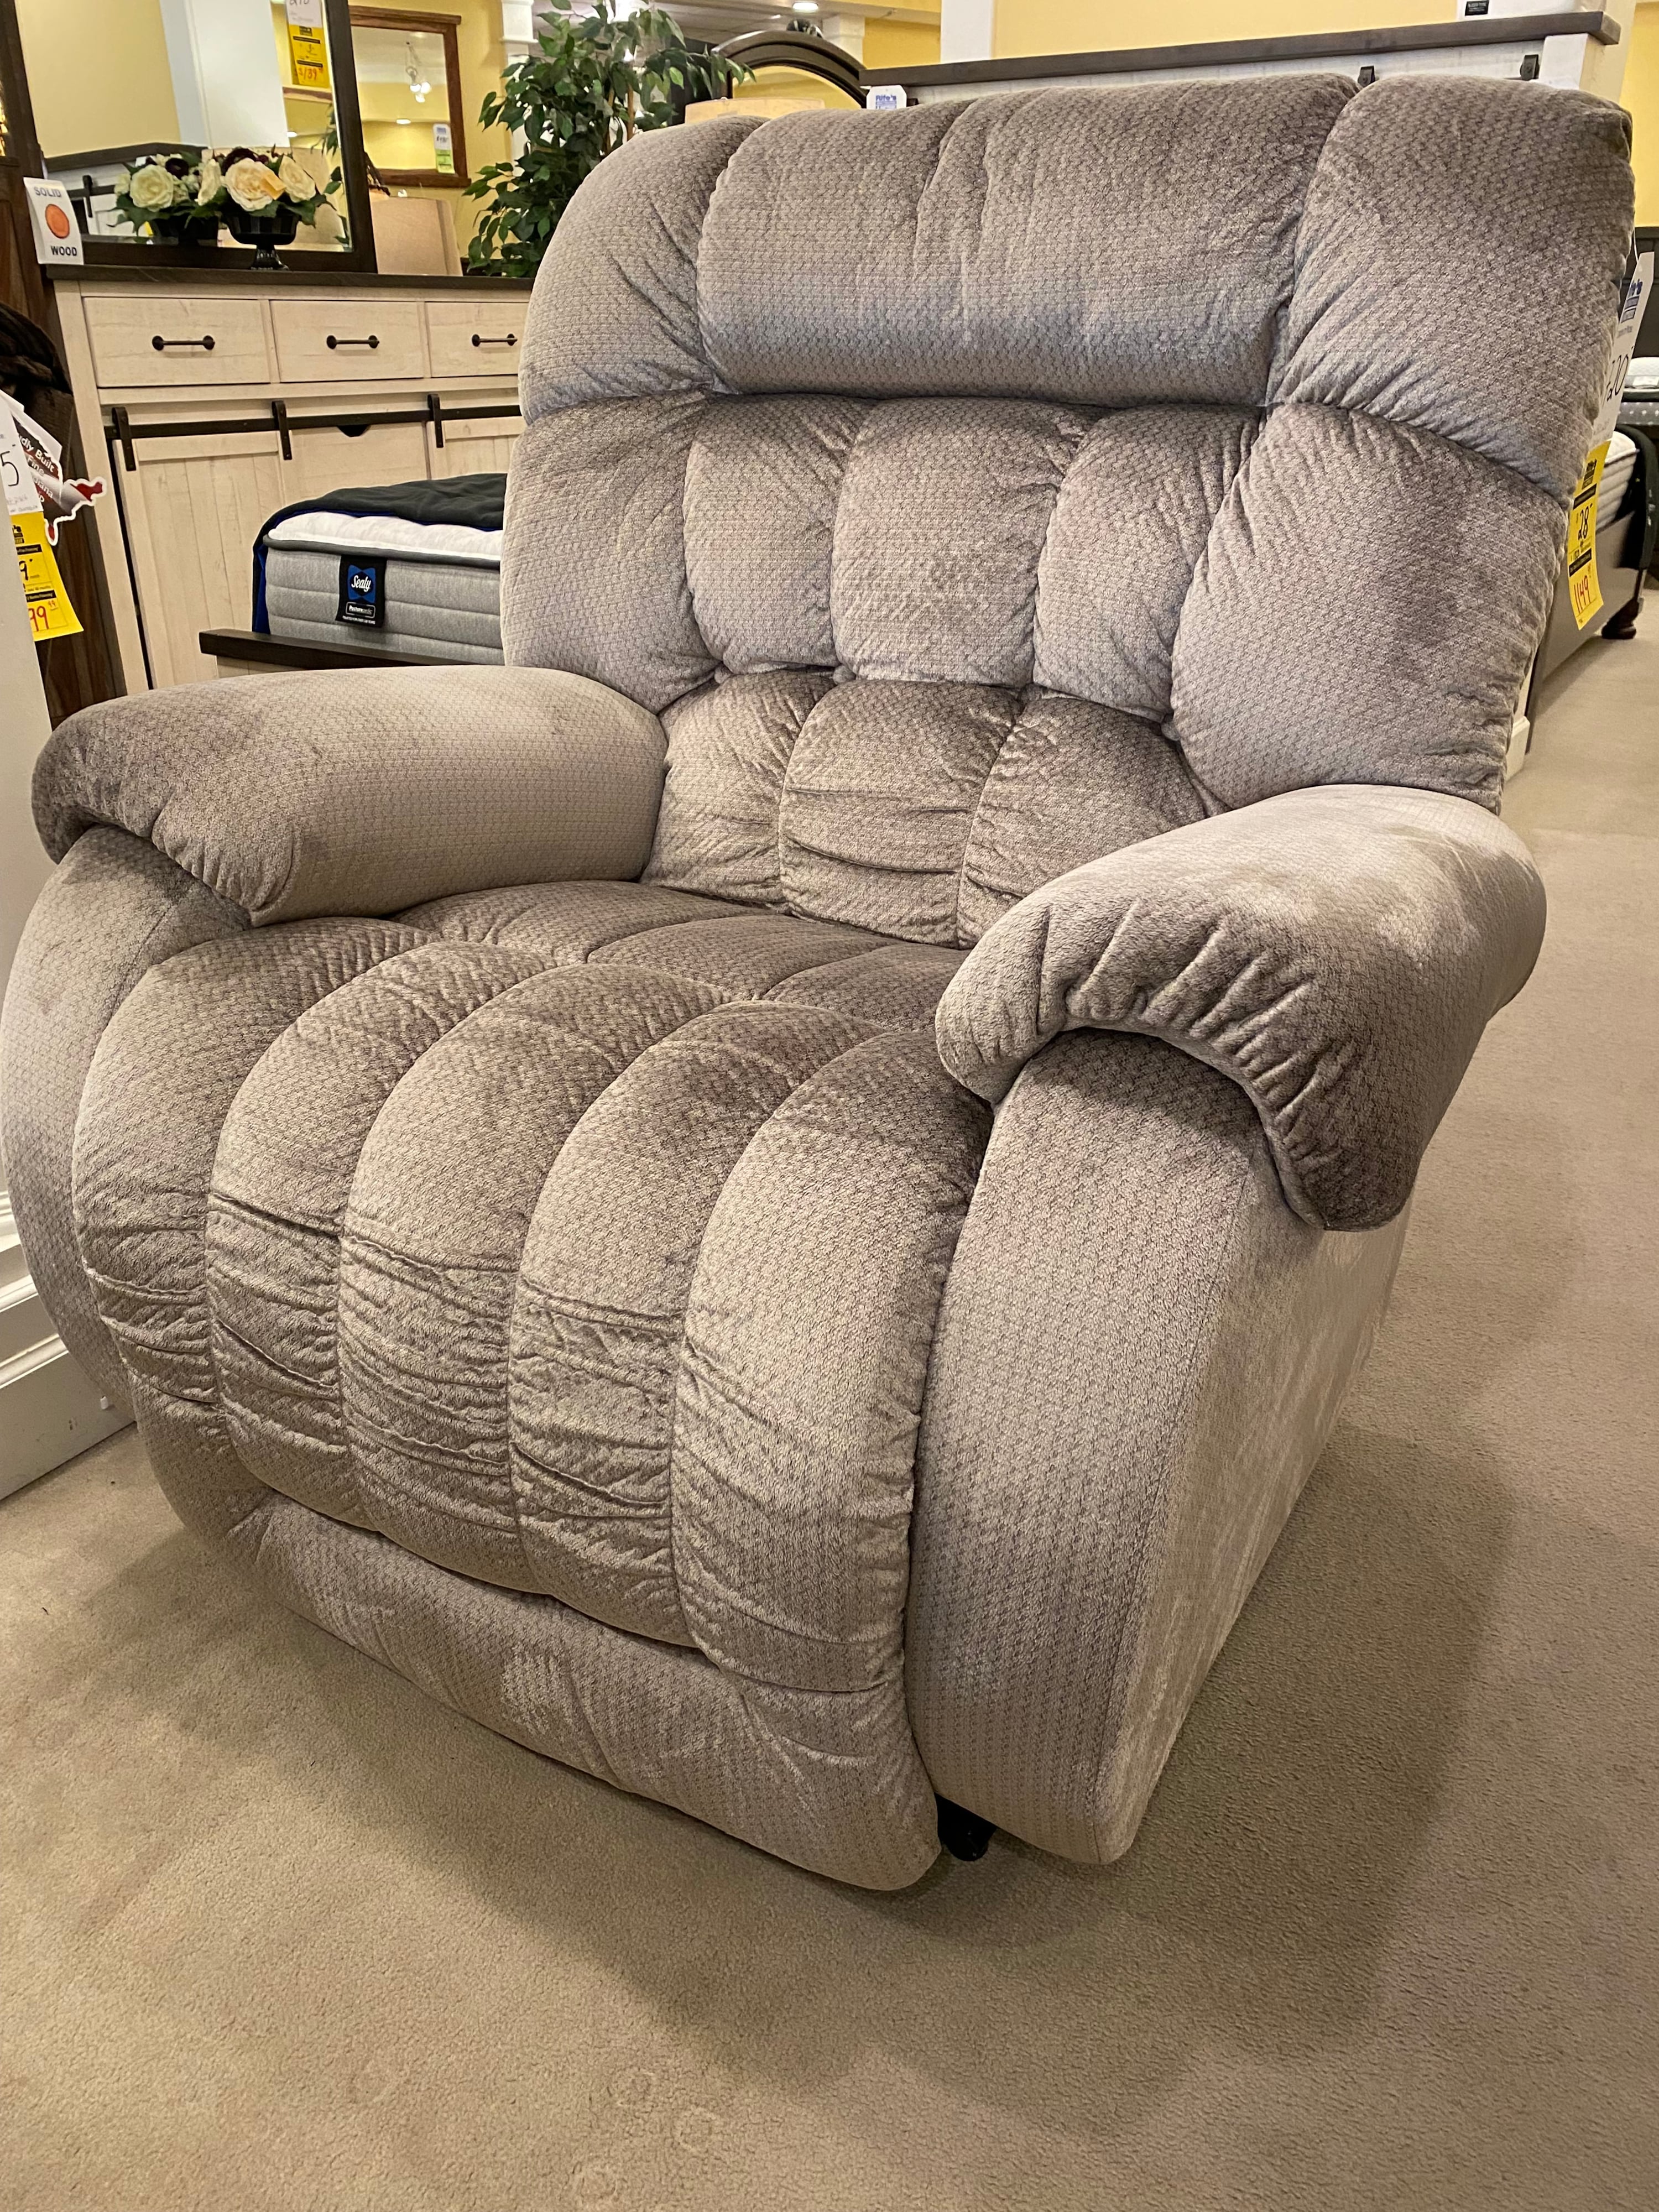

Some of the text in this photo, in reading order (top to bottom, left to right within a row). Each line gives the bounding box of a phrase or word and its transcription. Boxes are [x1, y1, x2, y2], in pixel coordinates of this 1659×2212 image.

[34, 186, 62, 197] SOLID
[51, 246, 77, 256] WOOD
[35, 449, 54, 473] Built
[351, 575, 372, 592] Sealy
[1574, 575, 1592, 614] 1149
